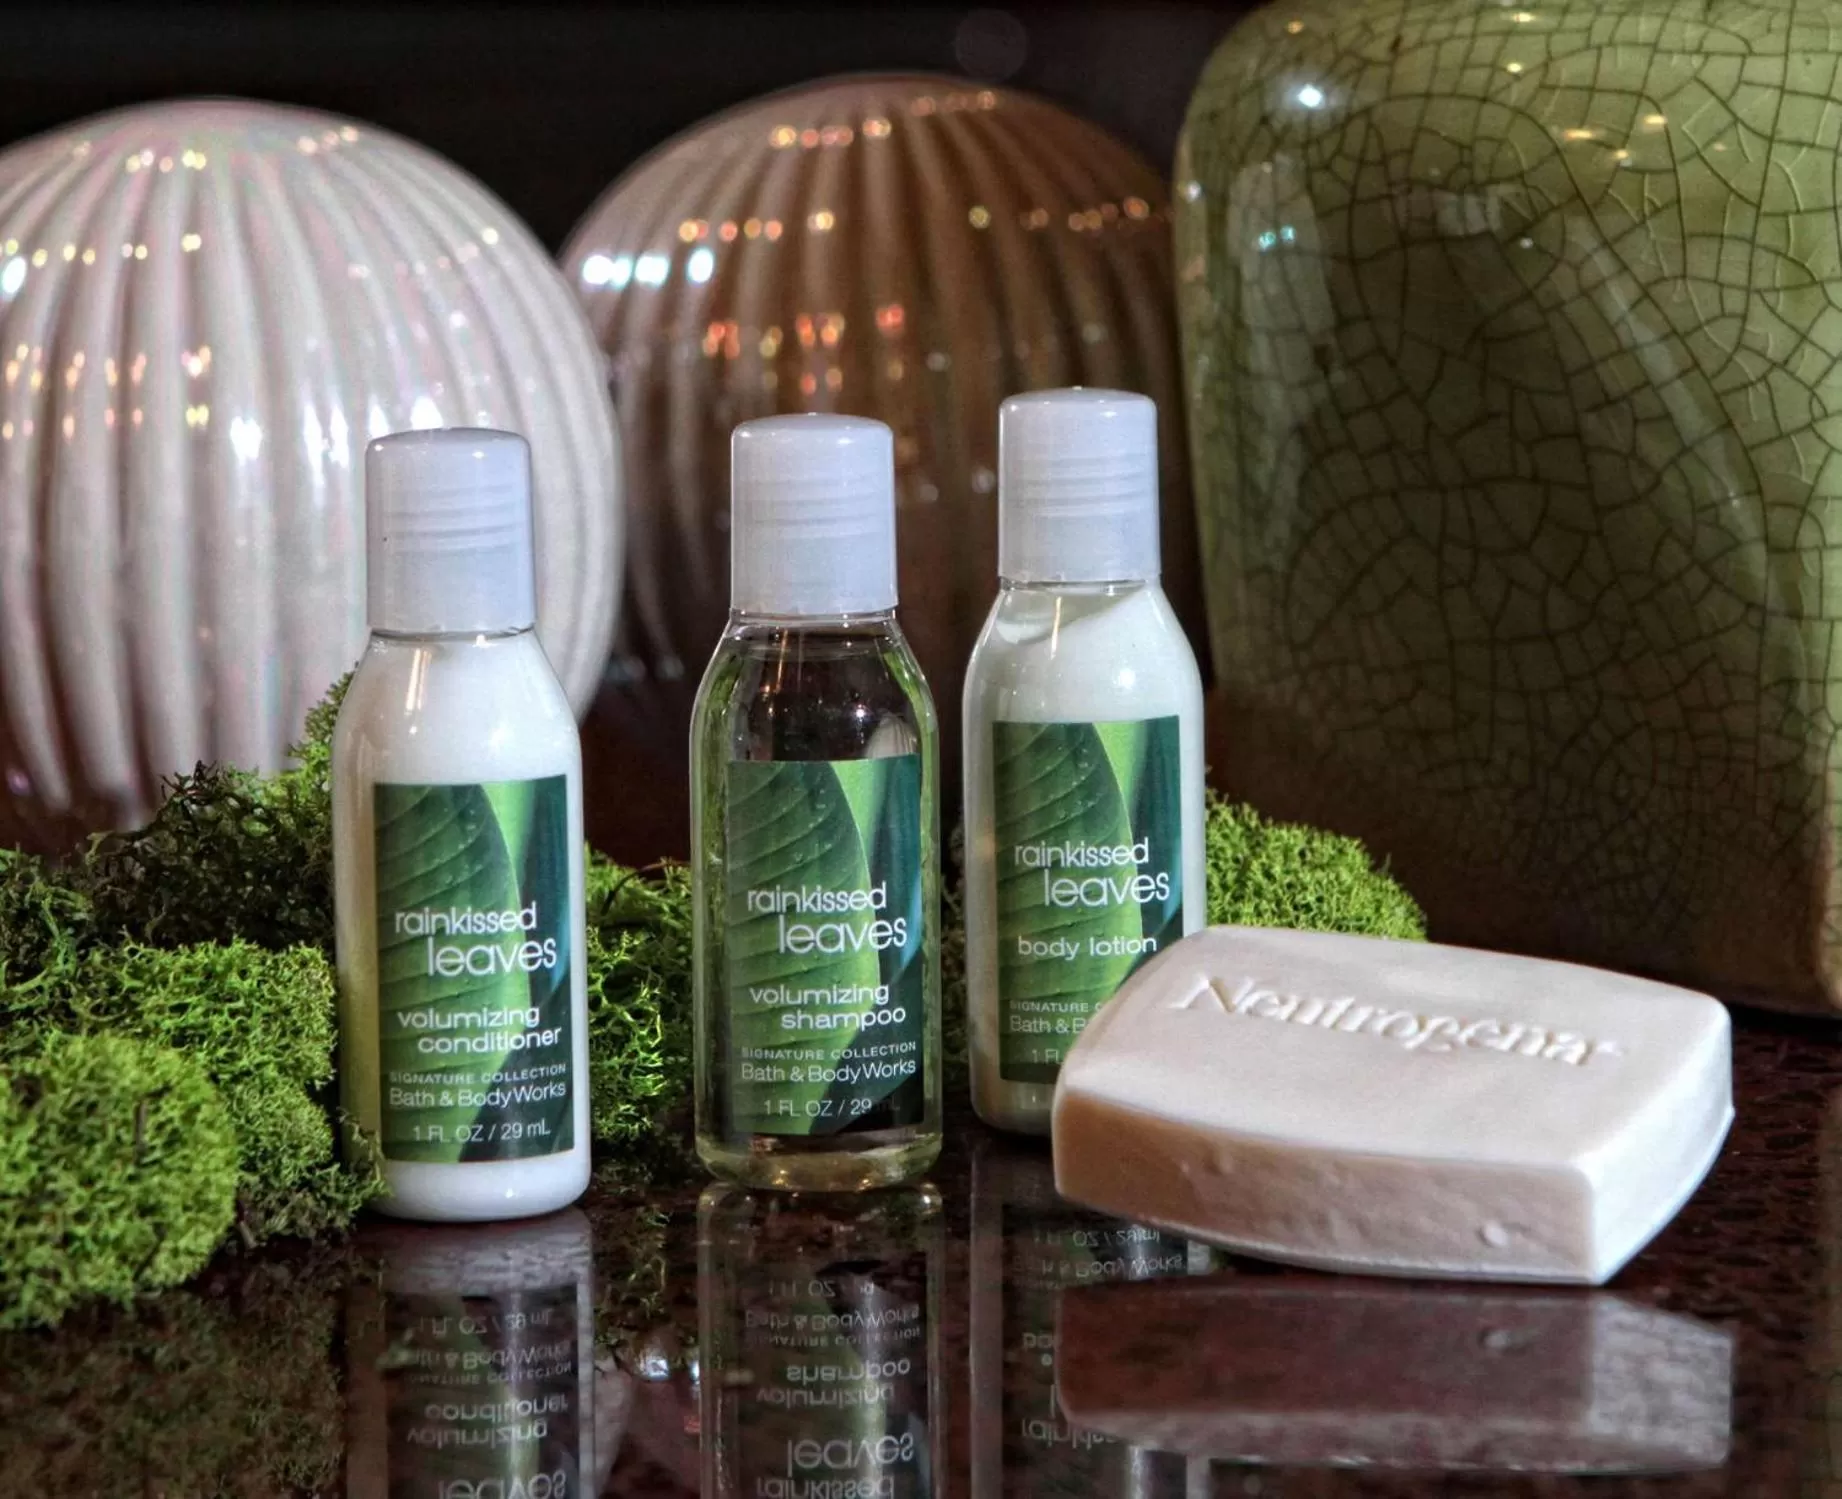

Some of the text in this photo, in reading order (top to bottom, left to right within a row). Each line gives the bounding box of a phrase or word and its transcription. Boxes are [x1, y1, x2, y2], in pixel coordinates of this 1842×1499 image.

[1014, 836, 1149, 868] rainkissed
[747, 881, 887, 914] rainkissed
[1043, 867, 1170, 907] leaves
[394, 901, 538, 936] rainkissed
[778, 913, 907, 954] leaves
[427, 935, 557, 977] leaves
[1017, 935, 1157, 960] body lotion
[749, 984, 889, 1008] volumizing
[1009, 1000, 1089, 1013] SIGNATURE
[397, 1006, 540, 1031] volumizing
[780, 1005, 906, 1033] shampoo
[1010, 1014, 1051, 1034] Bath
[1055, 1018, 1069, 1034] &
[417, 1026, 561, 1055] conditioner
[741, 1041, 916, 1060] SIGNATURE COLLECTION
[389, 1063, 567, 1085] SIGNATURE COLLECTION
[741, 1063, 785, 1082] Bath
[790, 1066, 804, 1082] &
[389, 1087, 435, 1107] Bath
[439, 1091, 454, 1107] &
[764, 1100, 771, 1116] 1
[805, 1100, 833, 1117] OZ
[836, 1100, 845, 1118] /
[850, 1098, 872, 1115] 29
[413, 1124, 421, 1141] 1
[456, 1123, 484, 1142] OZ
[488, 1124, 496, 1142] /
[501, 1123, 523, 1141] 29
[527, 1118, 551, 1137] mL
